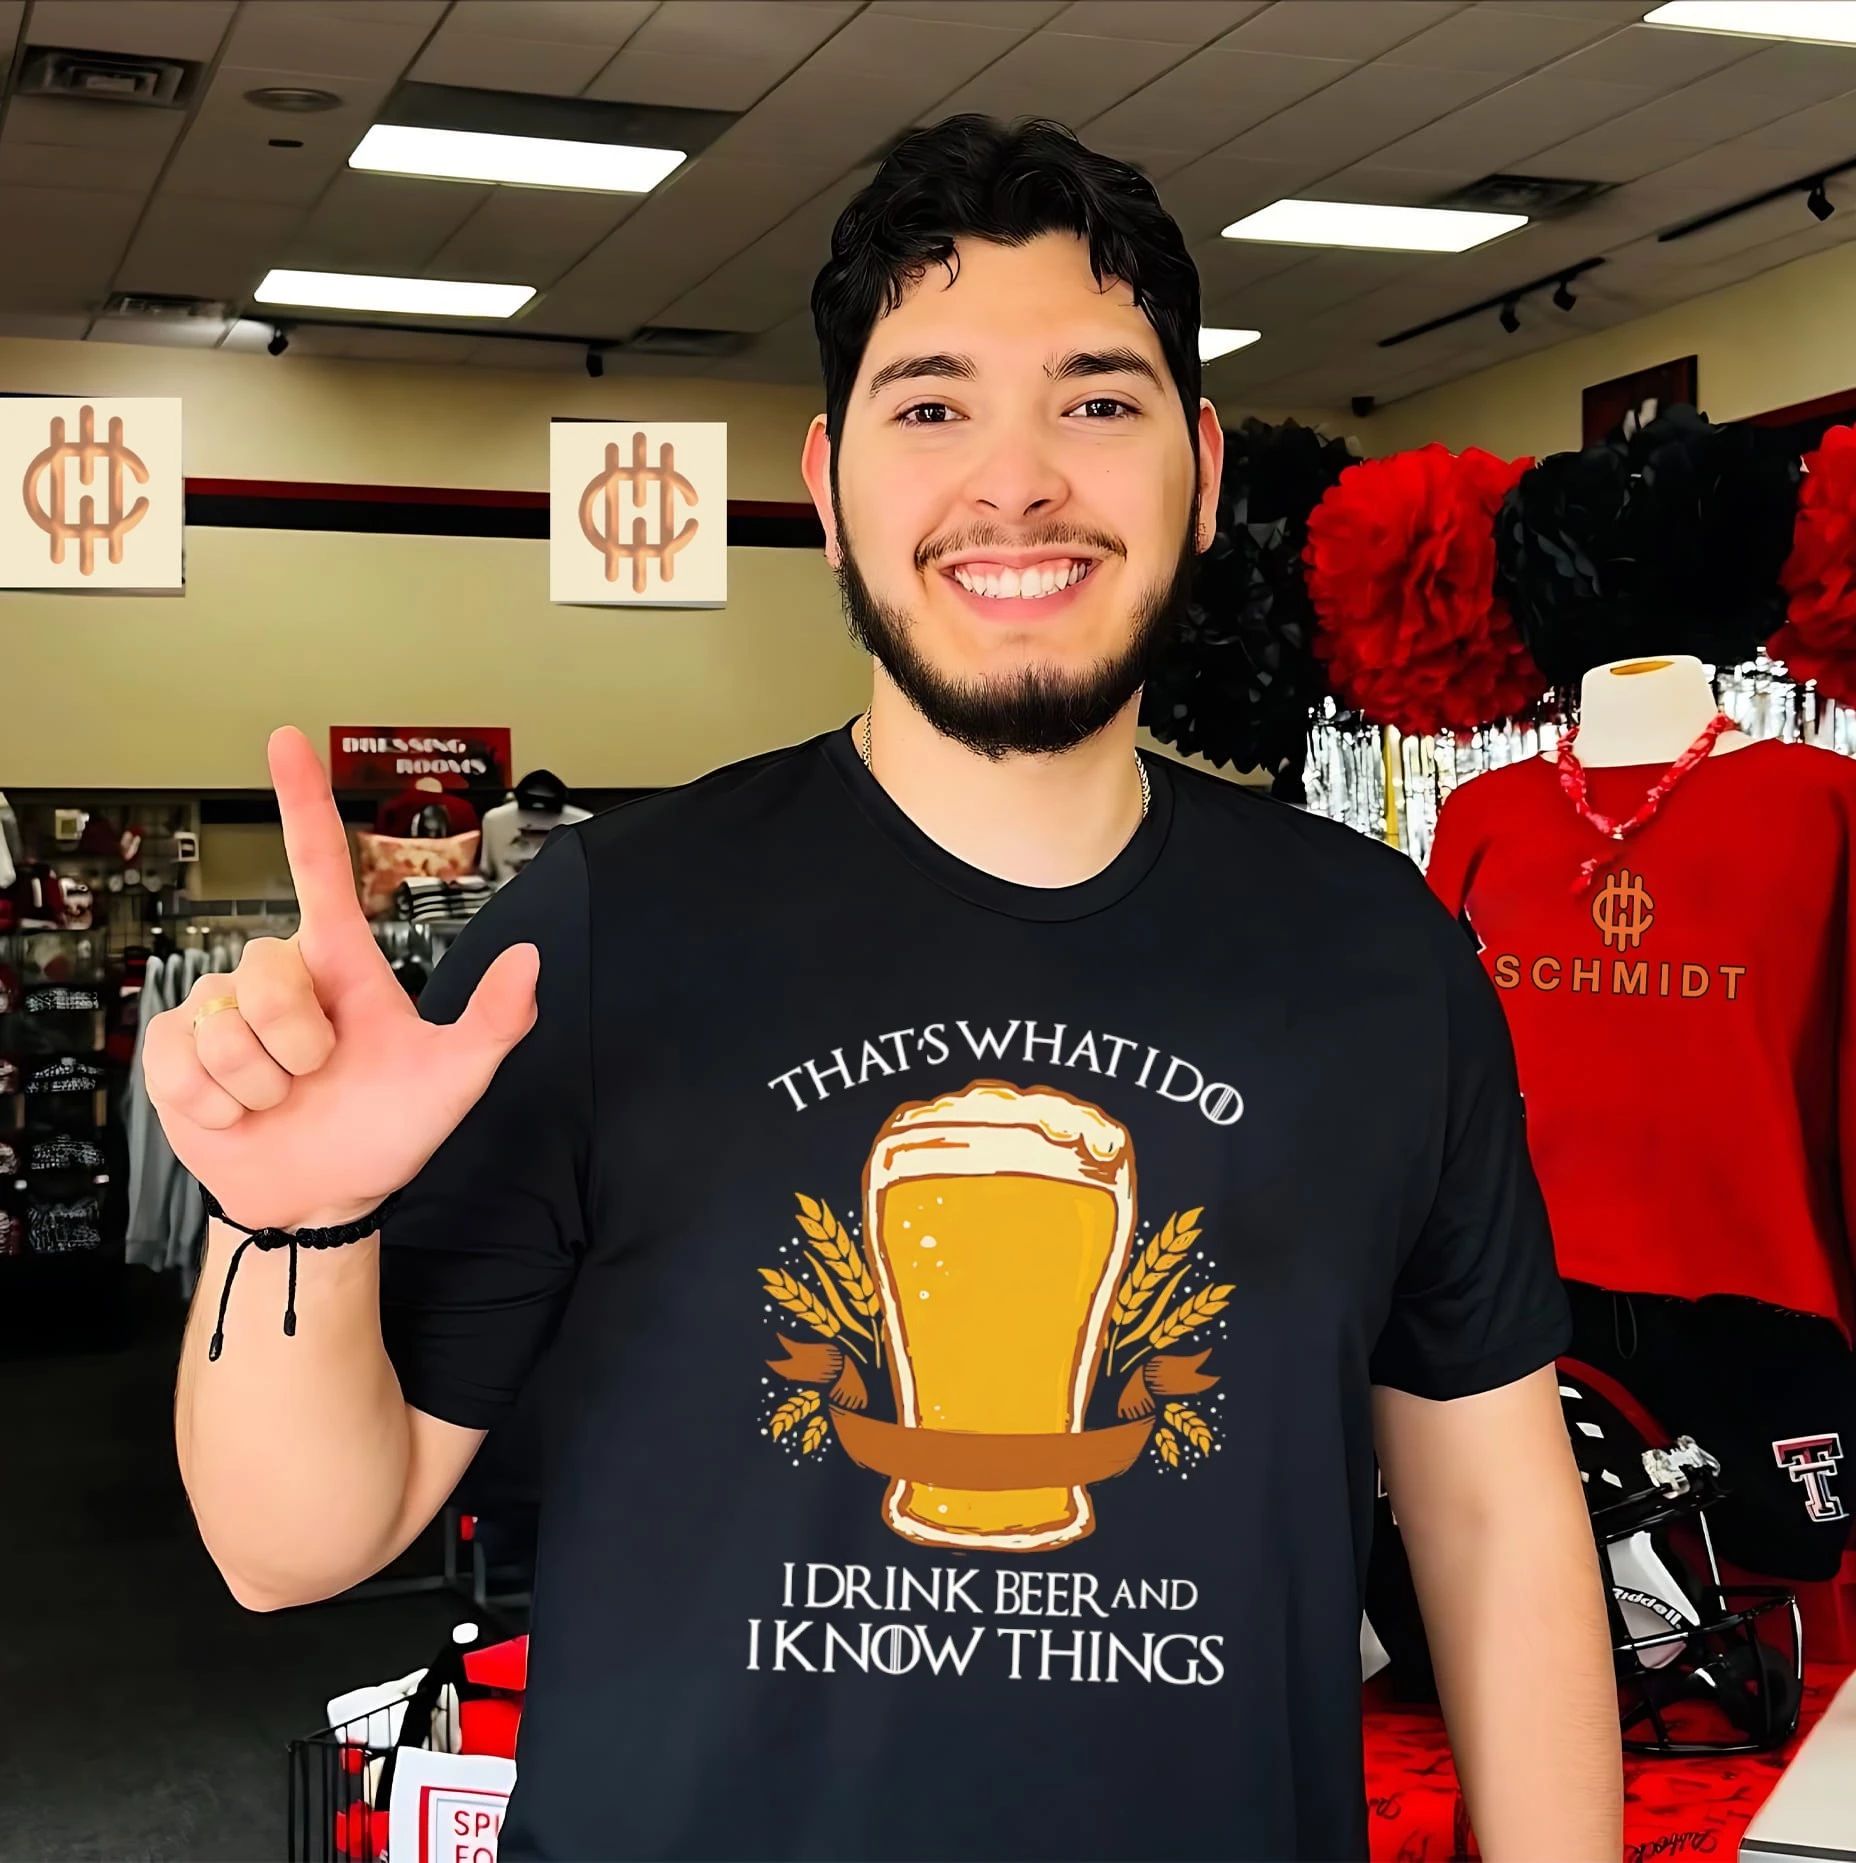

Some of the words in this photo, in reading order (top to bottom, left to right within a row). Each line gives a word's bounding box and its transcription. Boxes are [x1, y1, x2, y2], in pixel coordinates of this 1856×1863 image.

[396, 758, 487, 775] ROOMS
[1494, 955, 1747, 1000] SCHMIDT
[767, 1023, 950, 1112] THAT'S
[956, 1019, 1139, 1078] WHAT
[1135, 1046, 1160, 1088] I
[1155, 1055, 1244, 1126] DO
[781, 1562, 795, 1607] I
[804, 1562, 984, 1614] DRINK
[994, 1569, 1110, 1618] BEER
[1110, 1578, 1199, 1611] AND
[746, 1618, 762, 1670] I
[772, 1619, 986, 1676] KNOW
[996, 1628, 1225, 1686] THINGS
